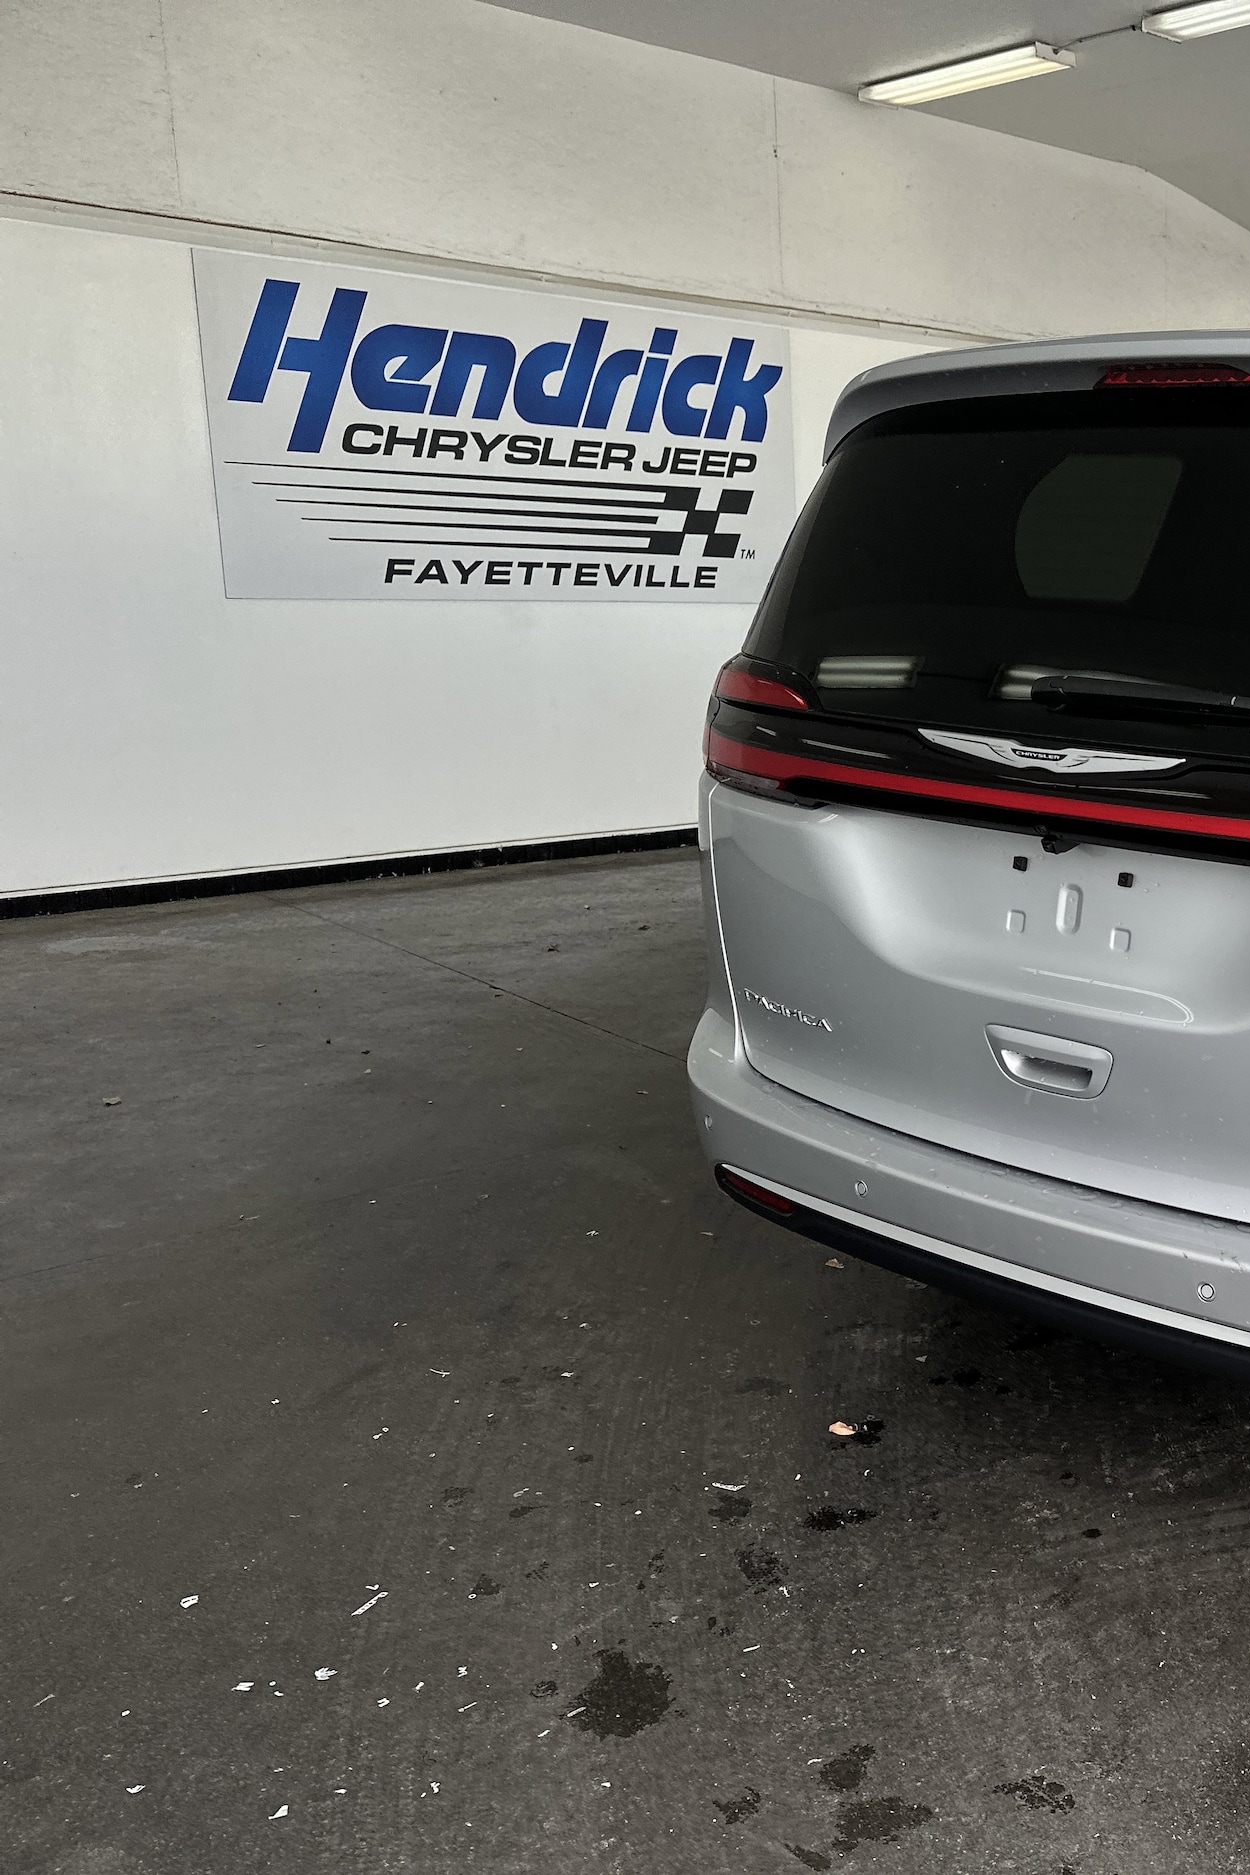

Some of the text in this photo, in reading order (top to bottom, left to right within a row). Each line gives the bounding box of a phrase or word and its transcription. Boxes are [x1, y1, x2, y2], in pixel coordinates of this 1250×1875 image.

[227, 278, 783, 454] Hendrick
[341, 422, 758, 478] CHRYSLER JEEP
[741, 549, 755, 559] TM
[384, 558, 718, 589] FAYETTEVILLE
[1015, 750, 1061, 760] CHRYSLER
[743, 987, 833, 1032] PACIFICA
